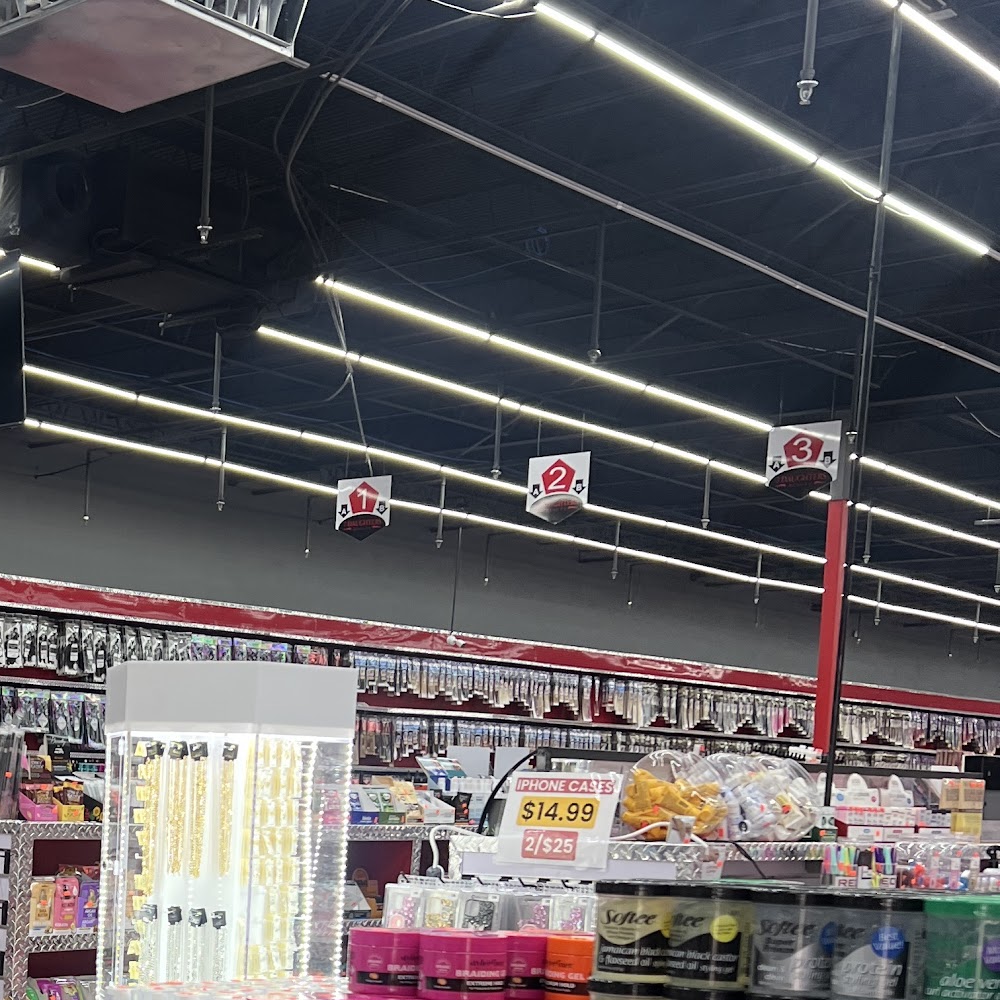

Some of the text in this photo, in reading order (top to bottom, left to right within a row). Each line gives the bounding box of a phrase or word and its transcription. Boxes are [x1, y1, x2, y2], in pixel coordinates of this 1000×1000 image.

[791, 437, 813, 462] 3
[548, 466, 567, 490] 2
[532, 488, 539, 496] A
[576, 483, 582, 491] B
[356, 488, 367, 510] 1
[341, 507, 347, 515] A
[379, 504, 385, 512] B
[516, 779, 614, 794] IPHONE CASES
[521, 800, 595, 822] $14.99
[525, 833, 574, 856] 2/$25
[601, 909, 658, 926] Softee
[878, 932, 898, 941] Best
[640, 957, 651, 967] oil
[687, 950, 739, 962] black castor
[687, 960, 698, 970] oil
[939, 973, 970, 990] aloe
